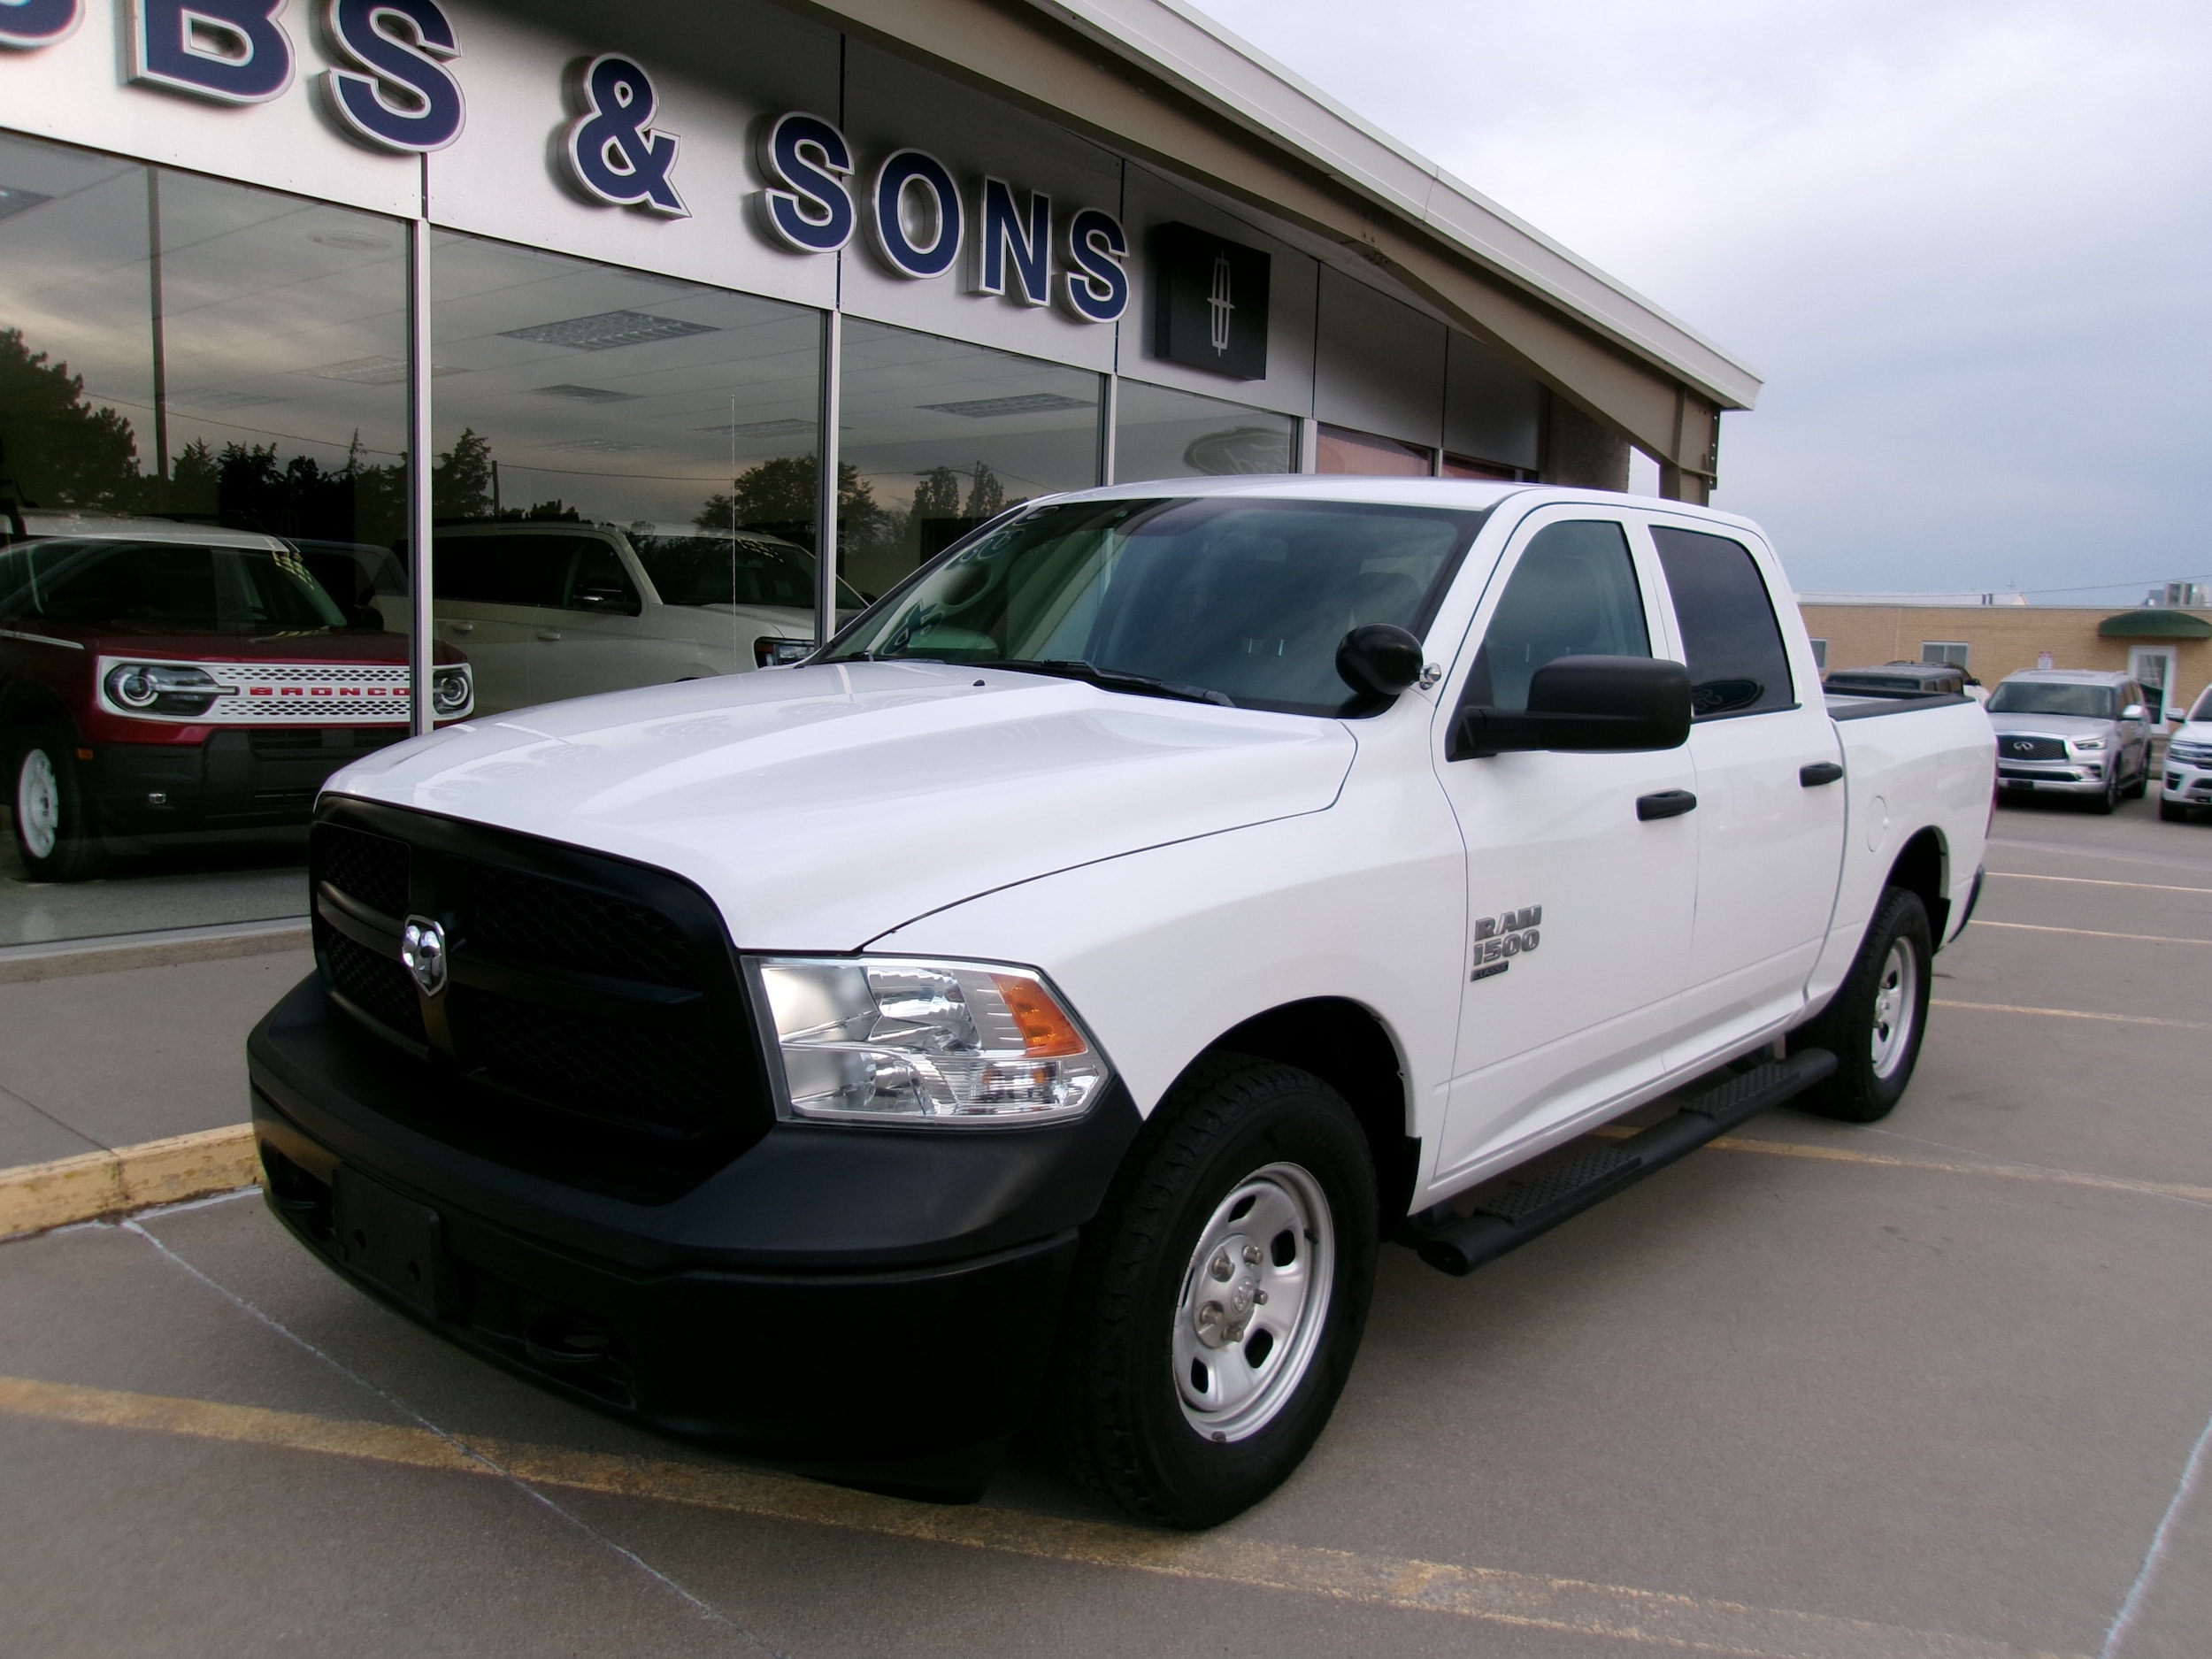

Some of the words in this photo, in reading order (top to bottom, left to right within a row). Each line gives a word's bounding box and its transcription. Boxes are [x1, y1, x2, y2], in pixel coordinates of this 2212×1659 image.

[0, 0, 466, 153] BS
[565, 52, 693, 219] &
[762, 111, 1131, 324] SONS
[250, 686, 411, 696] BRONCO
[1475, 904, 1542, 941] RAM
[1473, 929, 1540, 966] 1500
